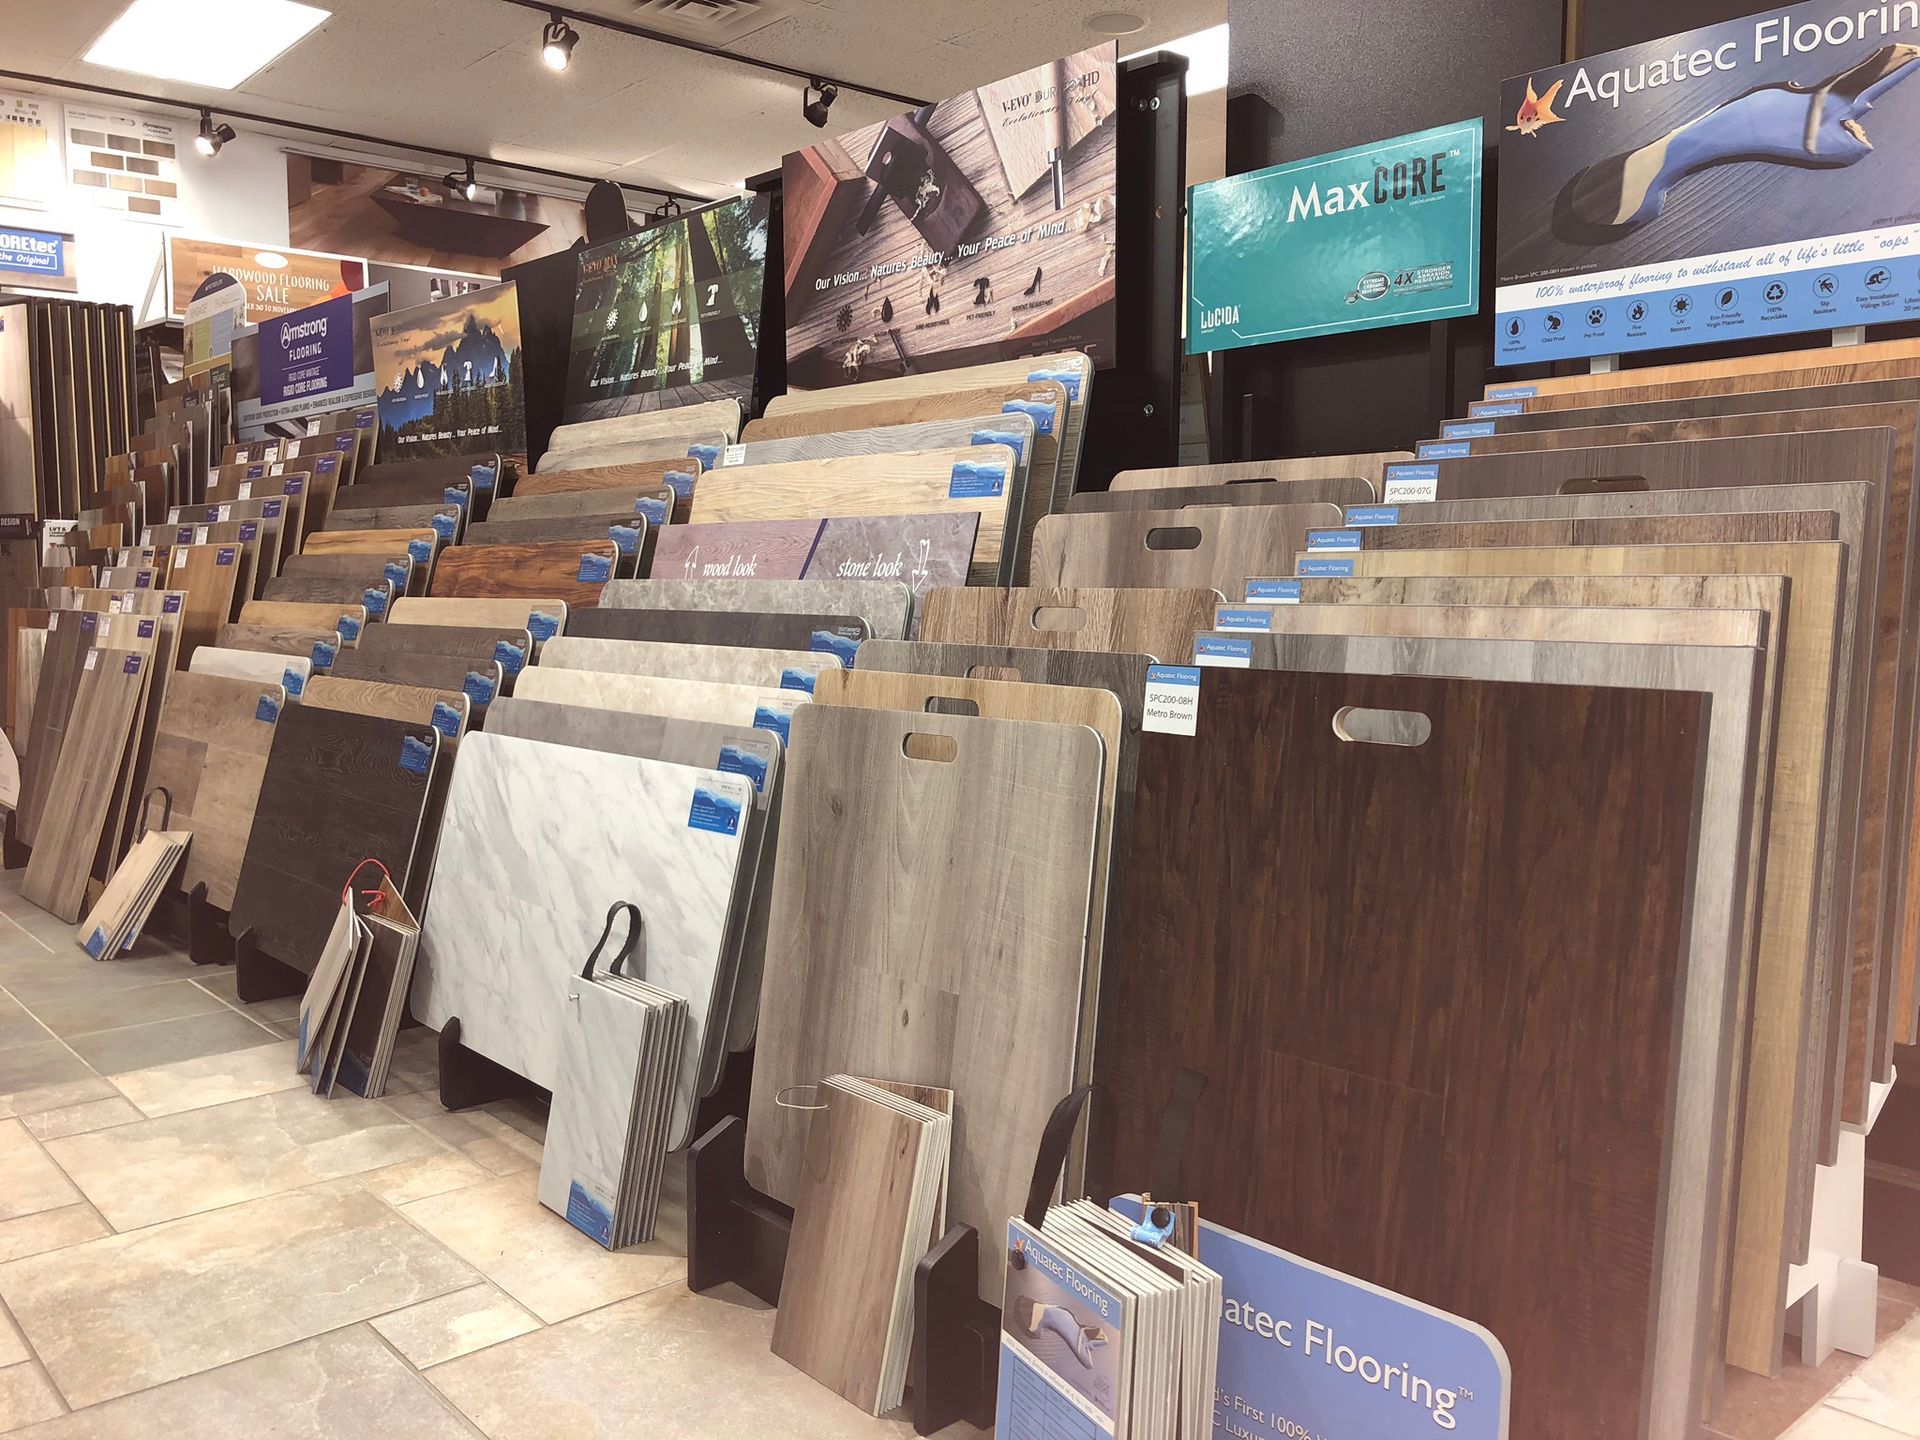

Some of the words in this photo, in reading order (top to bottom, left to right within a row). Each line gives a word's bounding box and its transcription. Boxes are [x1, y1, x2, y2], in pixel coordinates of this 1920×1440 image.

[1564, 40, 1737, 108] Aquatec
[1754, 0, 1919, 63] Floorin
[0, 233, 59, 254] OREtec
[16, 254, 50, 266] Original
[815, 278, 831, 291] Our
[833, 271, 868, 287] Vision...
[870, 262, 906, 279] Natures
[910, 251, 953, 269] Beauty...
[957, 241, 980, 258] Your
[984, 235, 1016, 252] Peace
[1021, 230, 1032, 243] of
[1037, 220, 1076, 239] Mind...
[1416, 265, 1452, 274] STRONGER
[1535, 284, 1564, 299] 100%
[1568, 275, 1625, 294] waterproof
[1628, 270, 1673, 290] flooring
[1677, 268, 1689, 279] to
[1692, 256, 1753, 276] withstand
[1756, 252, 1775, 266] all
[1778, 251, 1790, 267] of
[1833, 240, 1865, 255] little
[279, 274, 330, 292] FLOORING
[1394, 272, 1414, 286] 4X
[256, 284, 289, 304] SALE
[1200, 305, 1240, 329] LUCIDA
[281, 316, 328, 350] Armstrong
[288, 342, 322, 362] FLOORING
[294, 381, 306, 394] CORE
[306, 376, 328, 391] FLOORING
[1389, 486, 1432, 496] SPC200-07G
[0, 518, 20, 526] DESIGN
[1354, 513, 1373, 522] Aquatec
[1374, 512, 1394, 520] Flooring
[1316, 536, 1336, 544] Aquatec
[1336, 535, 1357, 544] Flooring
[702, 553, 732, 577] wood
[732, 553, 757, 577] look
[836, 557, 871, 578] stone
[872, 552, 904, 577] look
[1308, 564, 1327, 573] Aquatec
[1328, 564, 1349, 573] Flooring
[1256, 586, 1276, 594] Aquatec
[1276, 586, 1298, 596] Flooring
[1226, 616, 1245, 624] Aquatec
[1246, 616, 1267, 625] Flooring
[1206, 644, 1226, 652] Aquatec
[1226, 645, 1248, 654] Flooring
[1156, 670, 1176, 680] Aquatec
[1176, 672, 1198, 682] Flooring
[1149, 693, 1194, 706] SPC200-08H
[1146, 708, 1168, 718] Metro
[1169, 709, 1193, 720] Brown
[1024, 1239, 1064, 1280] Aquatec
[1066, 1269, 1109, 1317] Flooring
[1219, 1295, 1292, 1348] atec
[1304, 1318, 1458, 1430] Flooring
[1234, 1395, 1265, 1424] First
